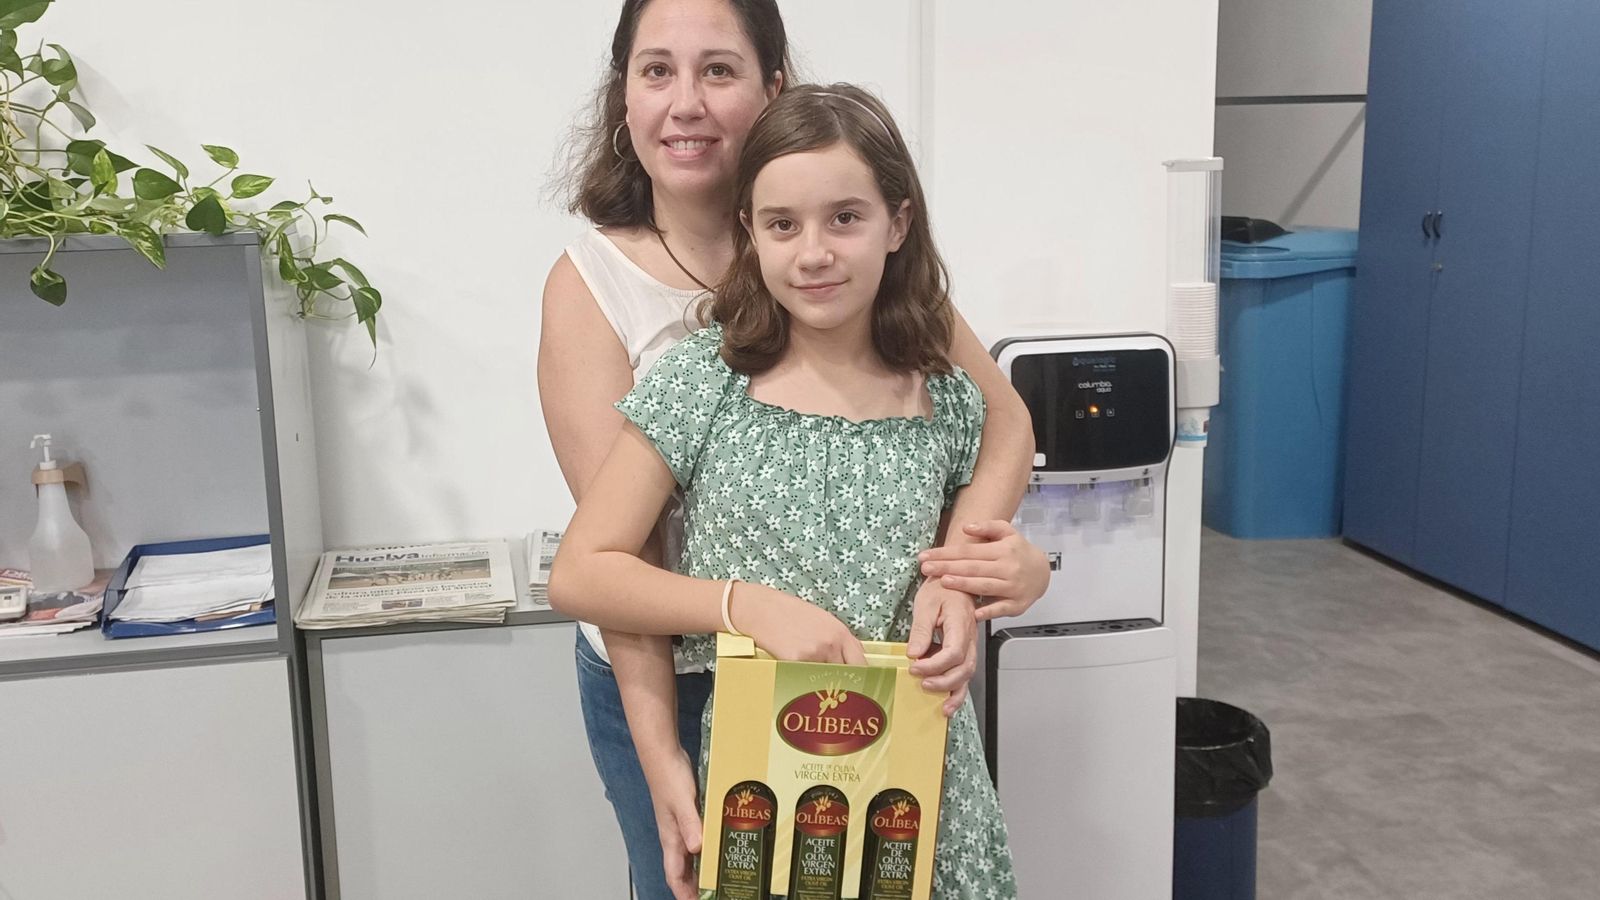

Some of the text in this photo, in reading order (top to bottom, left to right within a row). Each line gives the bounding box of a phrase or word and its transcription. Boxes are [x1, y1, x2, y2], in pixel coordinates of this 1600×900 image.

[335, 552, 420, 562] Huelva
[783, 712, 880, 737] OLIBEAS
[801, 763, 824, 771] ACEITE
[833, 764, 856, 773] OLIVA
[794, 770, 861, 782] VIRGEN EXTRA
[874, 816, 919, 830] OLIBEA
[728, 831, 759, 841] ACEITE
[737, 840, 749, 848] DE
[805, 838, 836, 848] ACEITE
[883, 841, 913, 851] ACEITE
[728, 846, 756, 855] OLIVA
[814, 846, 826, 854] DE
[891, 849, 903, 858] DE
[725, 853, 759, 863] VIRGEN
[805, 852, 833, 862] OLIVA
[882, 856, 910, 865] OLIVA
[727, 860, 756, 870] EXTRA
[801, 860, 836, 869] VIRGEN
[878, 863, 912, 873] VIRGEN
[803, 867, 832, 876] EXTRA
[880, 871, 908, 880] EXTRA
